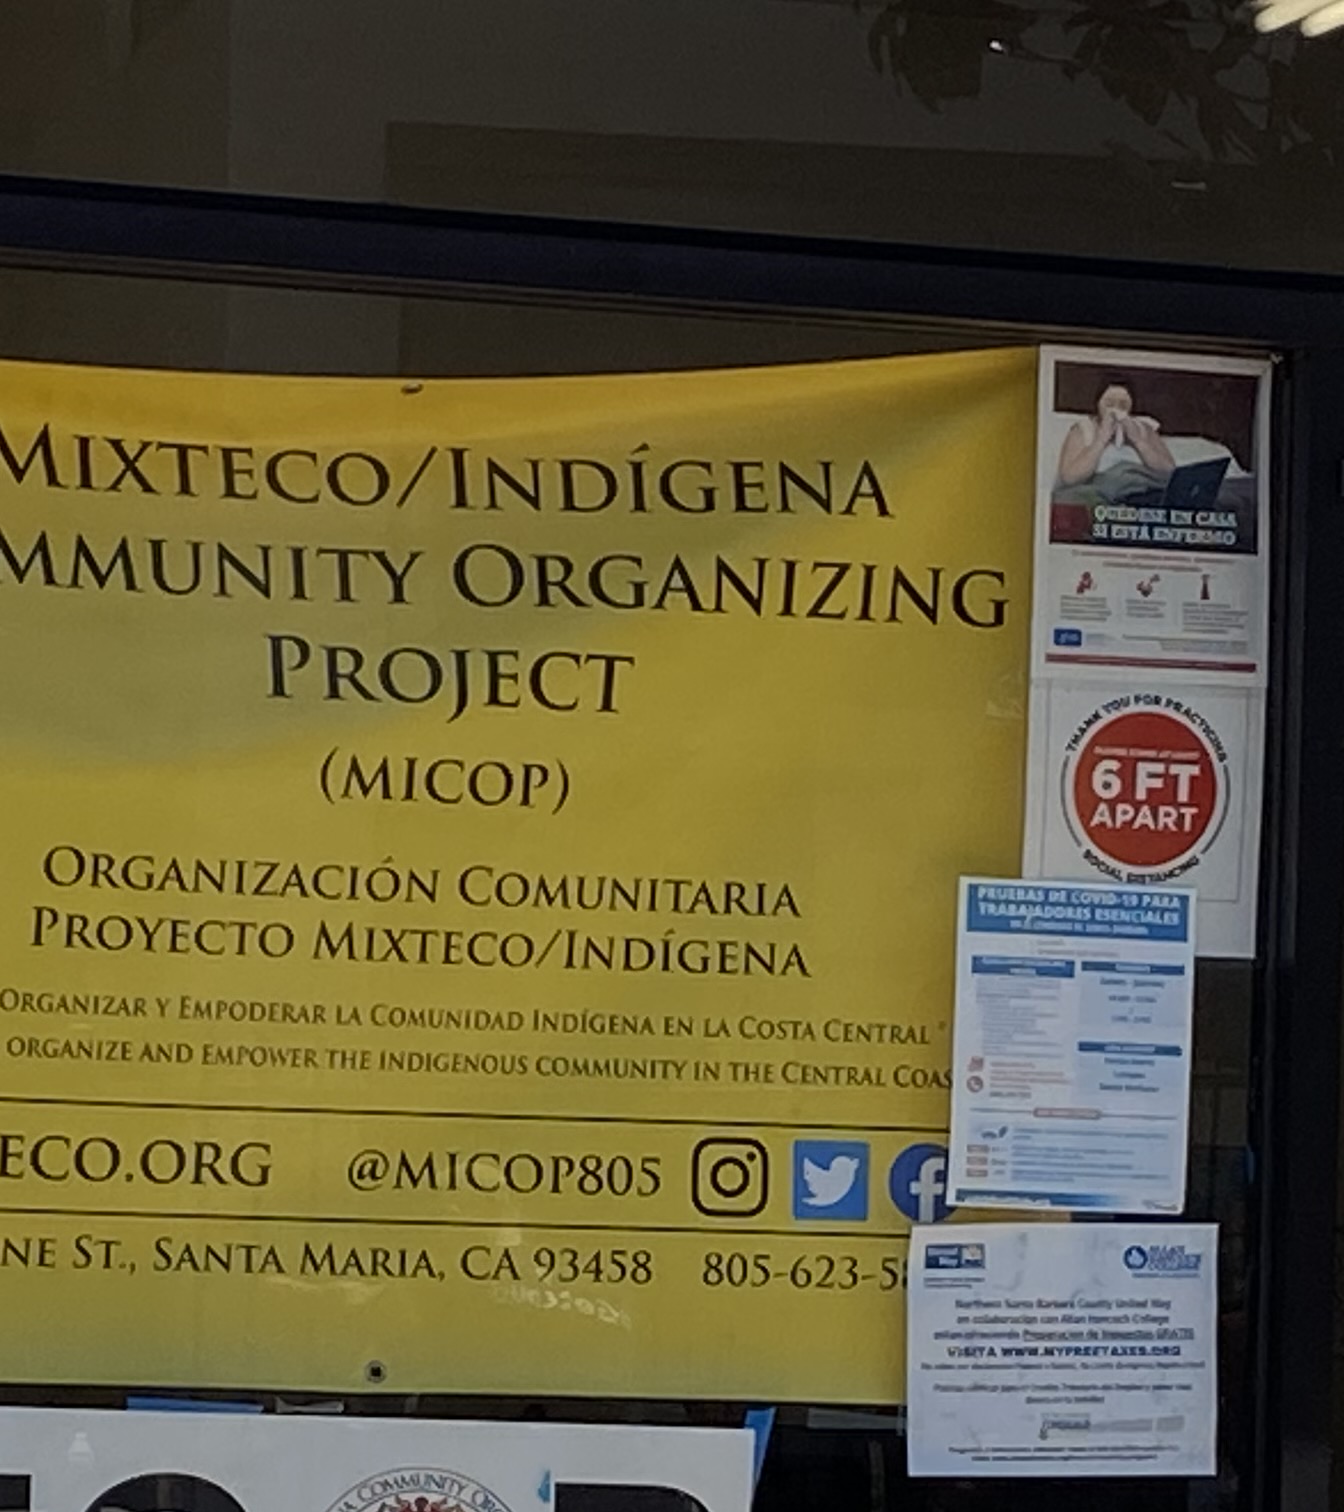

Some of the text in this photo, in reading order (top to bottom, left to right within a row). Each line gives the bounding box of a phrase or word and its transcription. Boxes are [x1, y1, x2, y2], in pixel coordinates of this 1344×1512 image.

[453, 543, 1009, 628] ORGANIZING
[264, 632, 635, 723] PROJECT
[1065, 710, 1103, 752] THANK
[1134, 693, 1162, 707] FOR
[320, 746, 570, 815] (MICOP)
[1091, 759, 1201, 802] 6 FT
[1090, 802, 1199, 832] APART
[43, 845, 803, 918] ORGANIZACIÓN COMUNITARIA
[30, 905, 812, 977] PROYECTO MIXTECO/INDÍGENA
[0, 987, 147, 1018] ORGANIZAR
[155, 997, 172, 1017] Y
[179, 996, 326, 1025] EMPODERAR
[336, 1005, 362, 1026] LA
[371, 1004, 523, 1031] COMUNIDAD
[663, 1016, 694, 1037] EN
[703, 1017, 731, 1039] LA
[738, 1016, 816, 1042] COSTA
[6, 1036, 133, 1062] ORGANIZE
[139, 1043, 194, 1064] AND
[201, 1043, 318, 1069] EMPOWER
[326, 1049, 371, 1070] THE
[378, 1050, 528, 1076] INDIGENOUS
[536, 1055, 688, 1082] COMMUNITY
[694, 1059, 721, 1082] IN
[728, 1060, 774, 1085] THE
[781, 1061, 886, 1087] CENTRAL
[348, 1149, 662, 1198] @MICOP805
[72, 1234, 136, 1275] ST.,
[153, 1236, 286, 1275] SANTA
[300, 1242, 446, 1282] MARIA,
[460, 1245, 521, 1282] CA
[533, 1247, 653, 1286] 93458
[703, 1251, 908, 1292] 805-623-5
